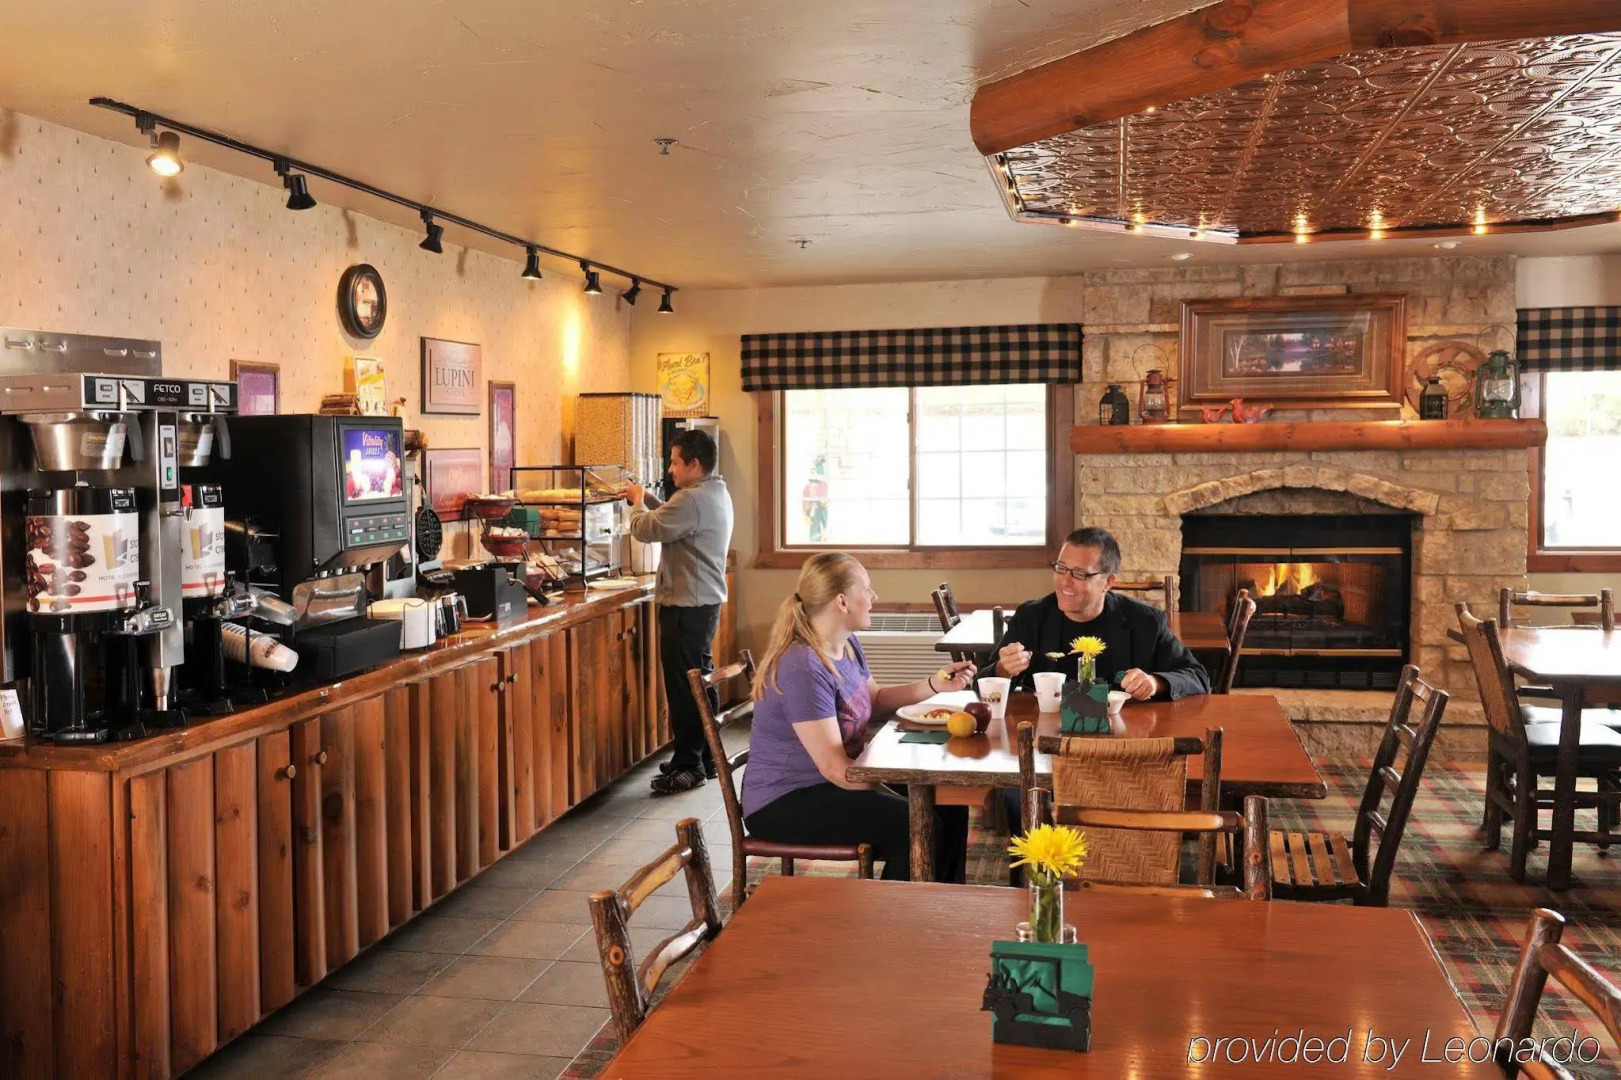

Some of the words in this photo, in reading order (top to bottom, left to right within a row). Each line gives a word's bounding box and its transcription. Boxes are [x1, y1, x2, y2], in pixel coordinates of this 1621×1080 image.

[661, 356, 682, 372] Aunt
[434, 367, 475, 388] LUPINI
[153, 383, 181, 394] FETCO
[362, 431, 384, 450] Vitality
